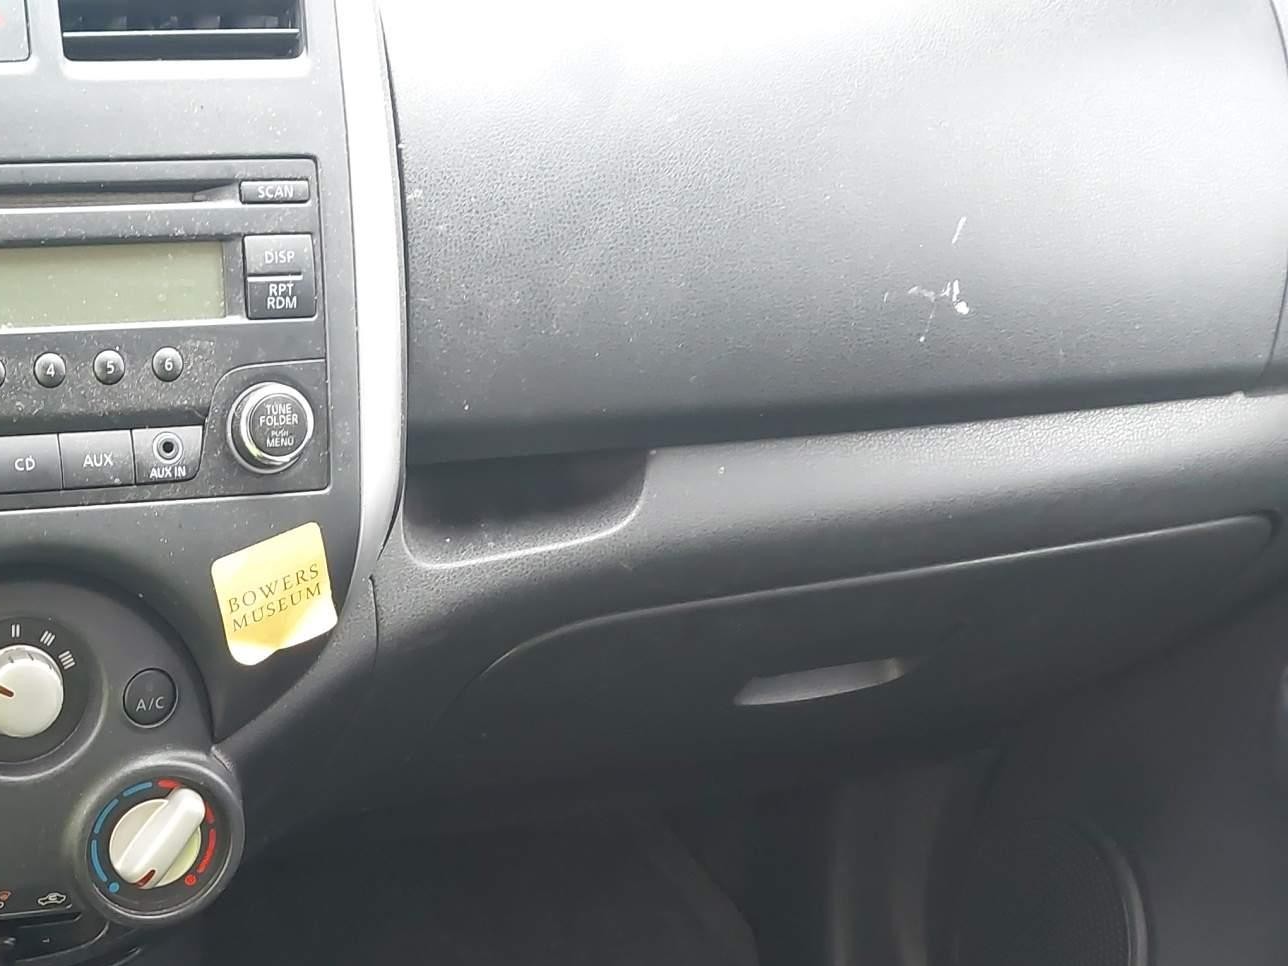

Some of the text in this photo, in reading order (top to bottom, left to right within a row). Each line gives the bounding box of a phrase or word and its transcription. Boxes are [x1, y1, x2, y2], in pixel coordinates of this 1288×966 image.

[257, 185, 294, 198] SCAN
[264, 250, 295, 264] DISP
[269, 283, 294, 297] RPT
[267, 296, 297, 310] RDM
[46, 364, 56, 378] 4
[106, 361, 115, 375] 5
[164, 358, 173, 372] 6
[265, 403, 293, 416] TUNE
[259, 413, 299, 427] FOLDER
[271, 428, 289, 437] PUSH
[266, 436, 295, 448] MENU
[14, 457, 36, 471] CD
[83, 454, 114, 468] AUX
[149, 466, 186, 479] AUX IN
[228, 563, 320, 614] BOWERS
[233, 582, 322, 632] MUSEUM
[136, 696, 164, 712] A/C
